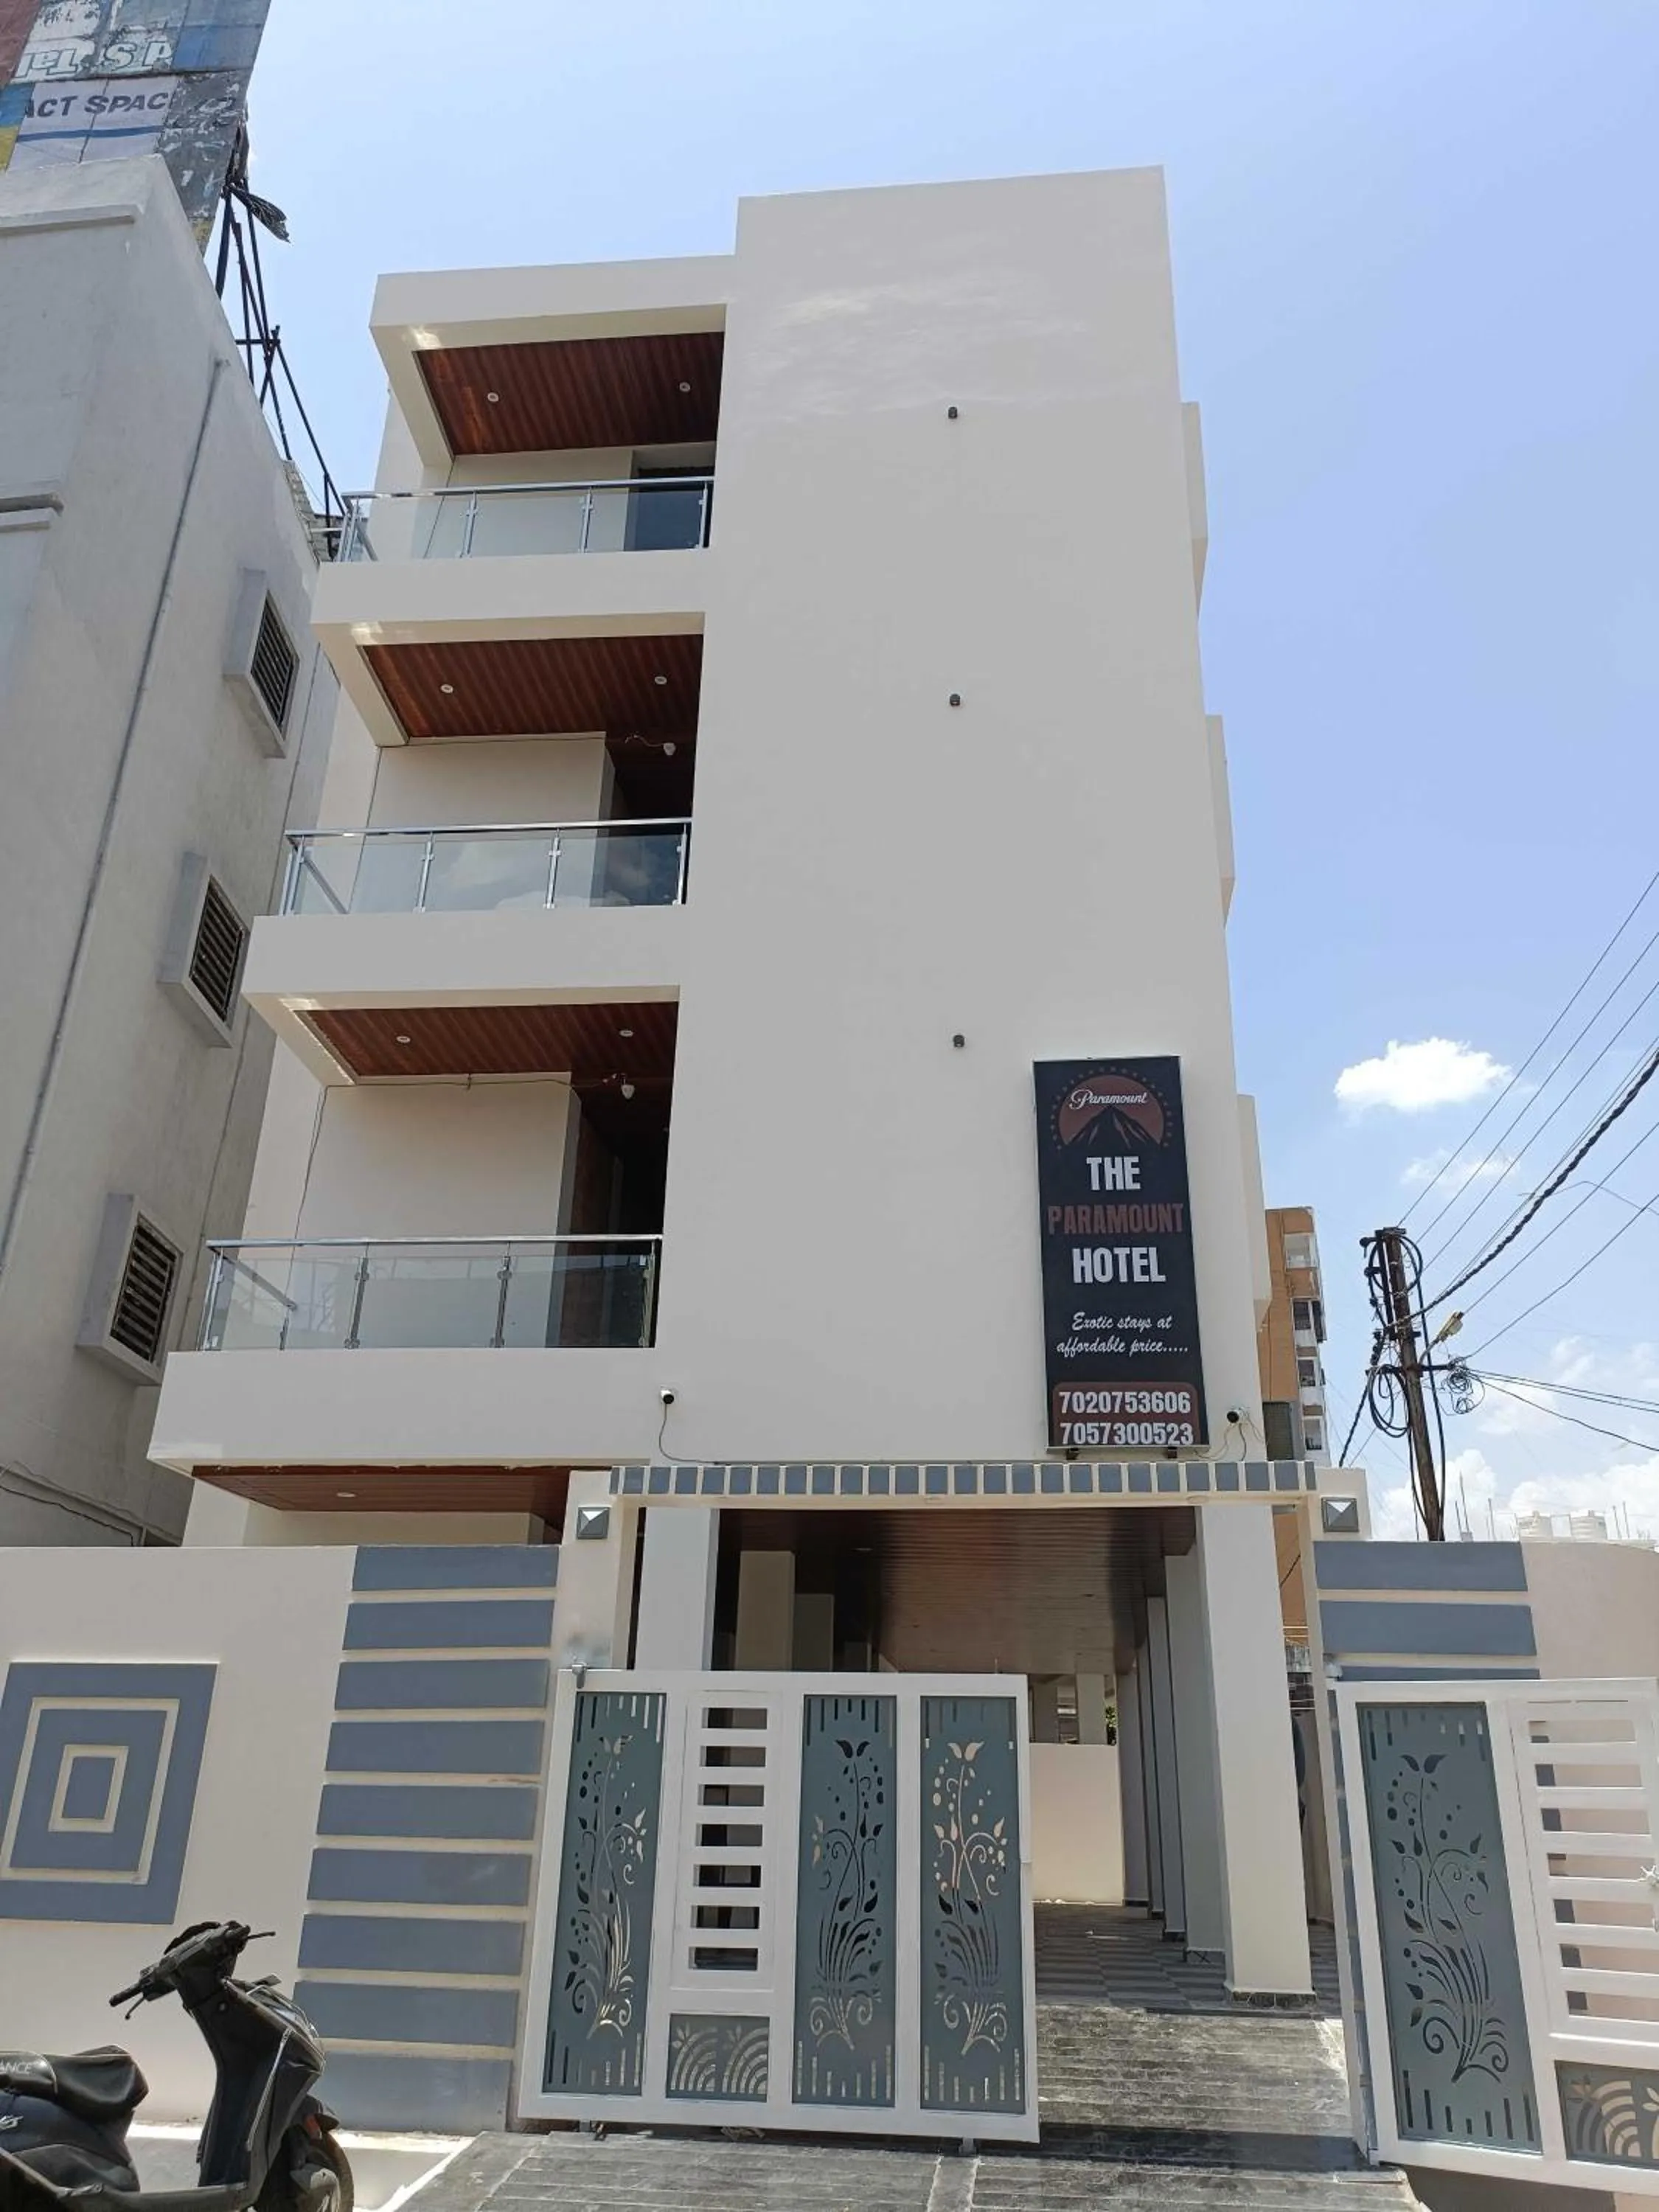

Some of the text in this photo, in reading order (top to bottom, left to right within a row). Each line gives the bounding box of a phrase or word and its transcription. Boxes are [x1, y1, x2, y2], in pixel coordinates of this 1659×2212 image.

[1069, 1089, 1147, 1110] Paramount
[1086, 1156, 1141, 1191] THE
[1047, 1203, 1183, 1235] PARAMOUNT
[1072, 1247, 1166, 1283] HOTEL
[1072, 1312, 1172, 1333] Exotic stays at
[1057, 1335, 1126, 1357] affordable
[1059, 1391, 1191, 1413] 7020753606
[1060, 1422, 1194, 1445] 7057300523
